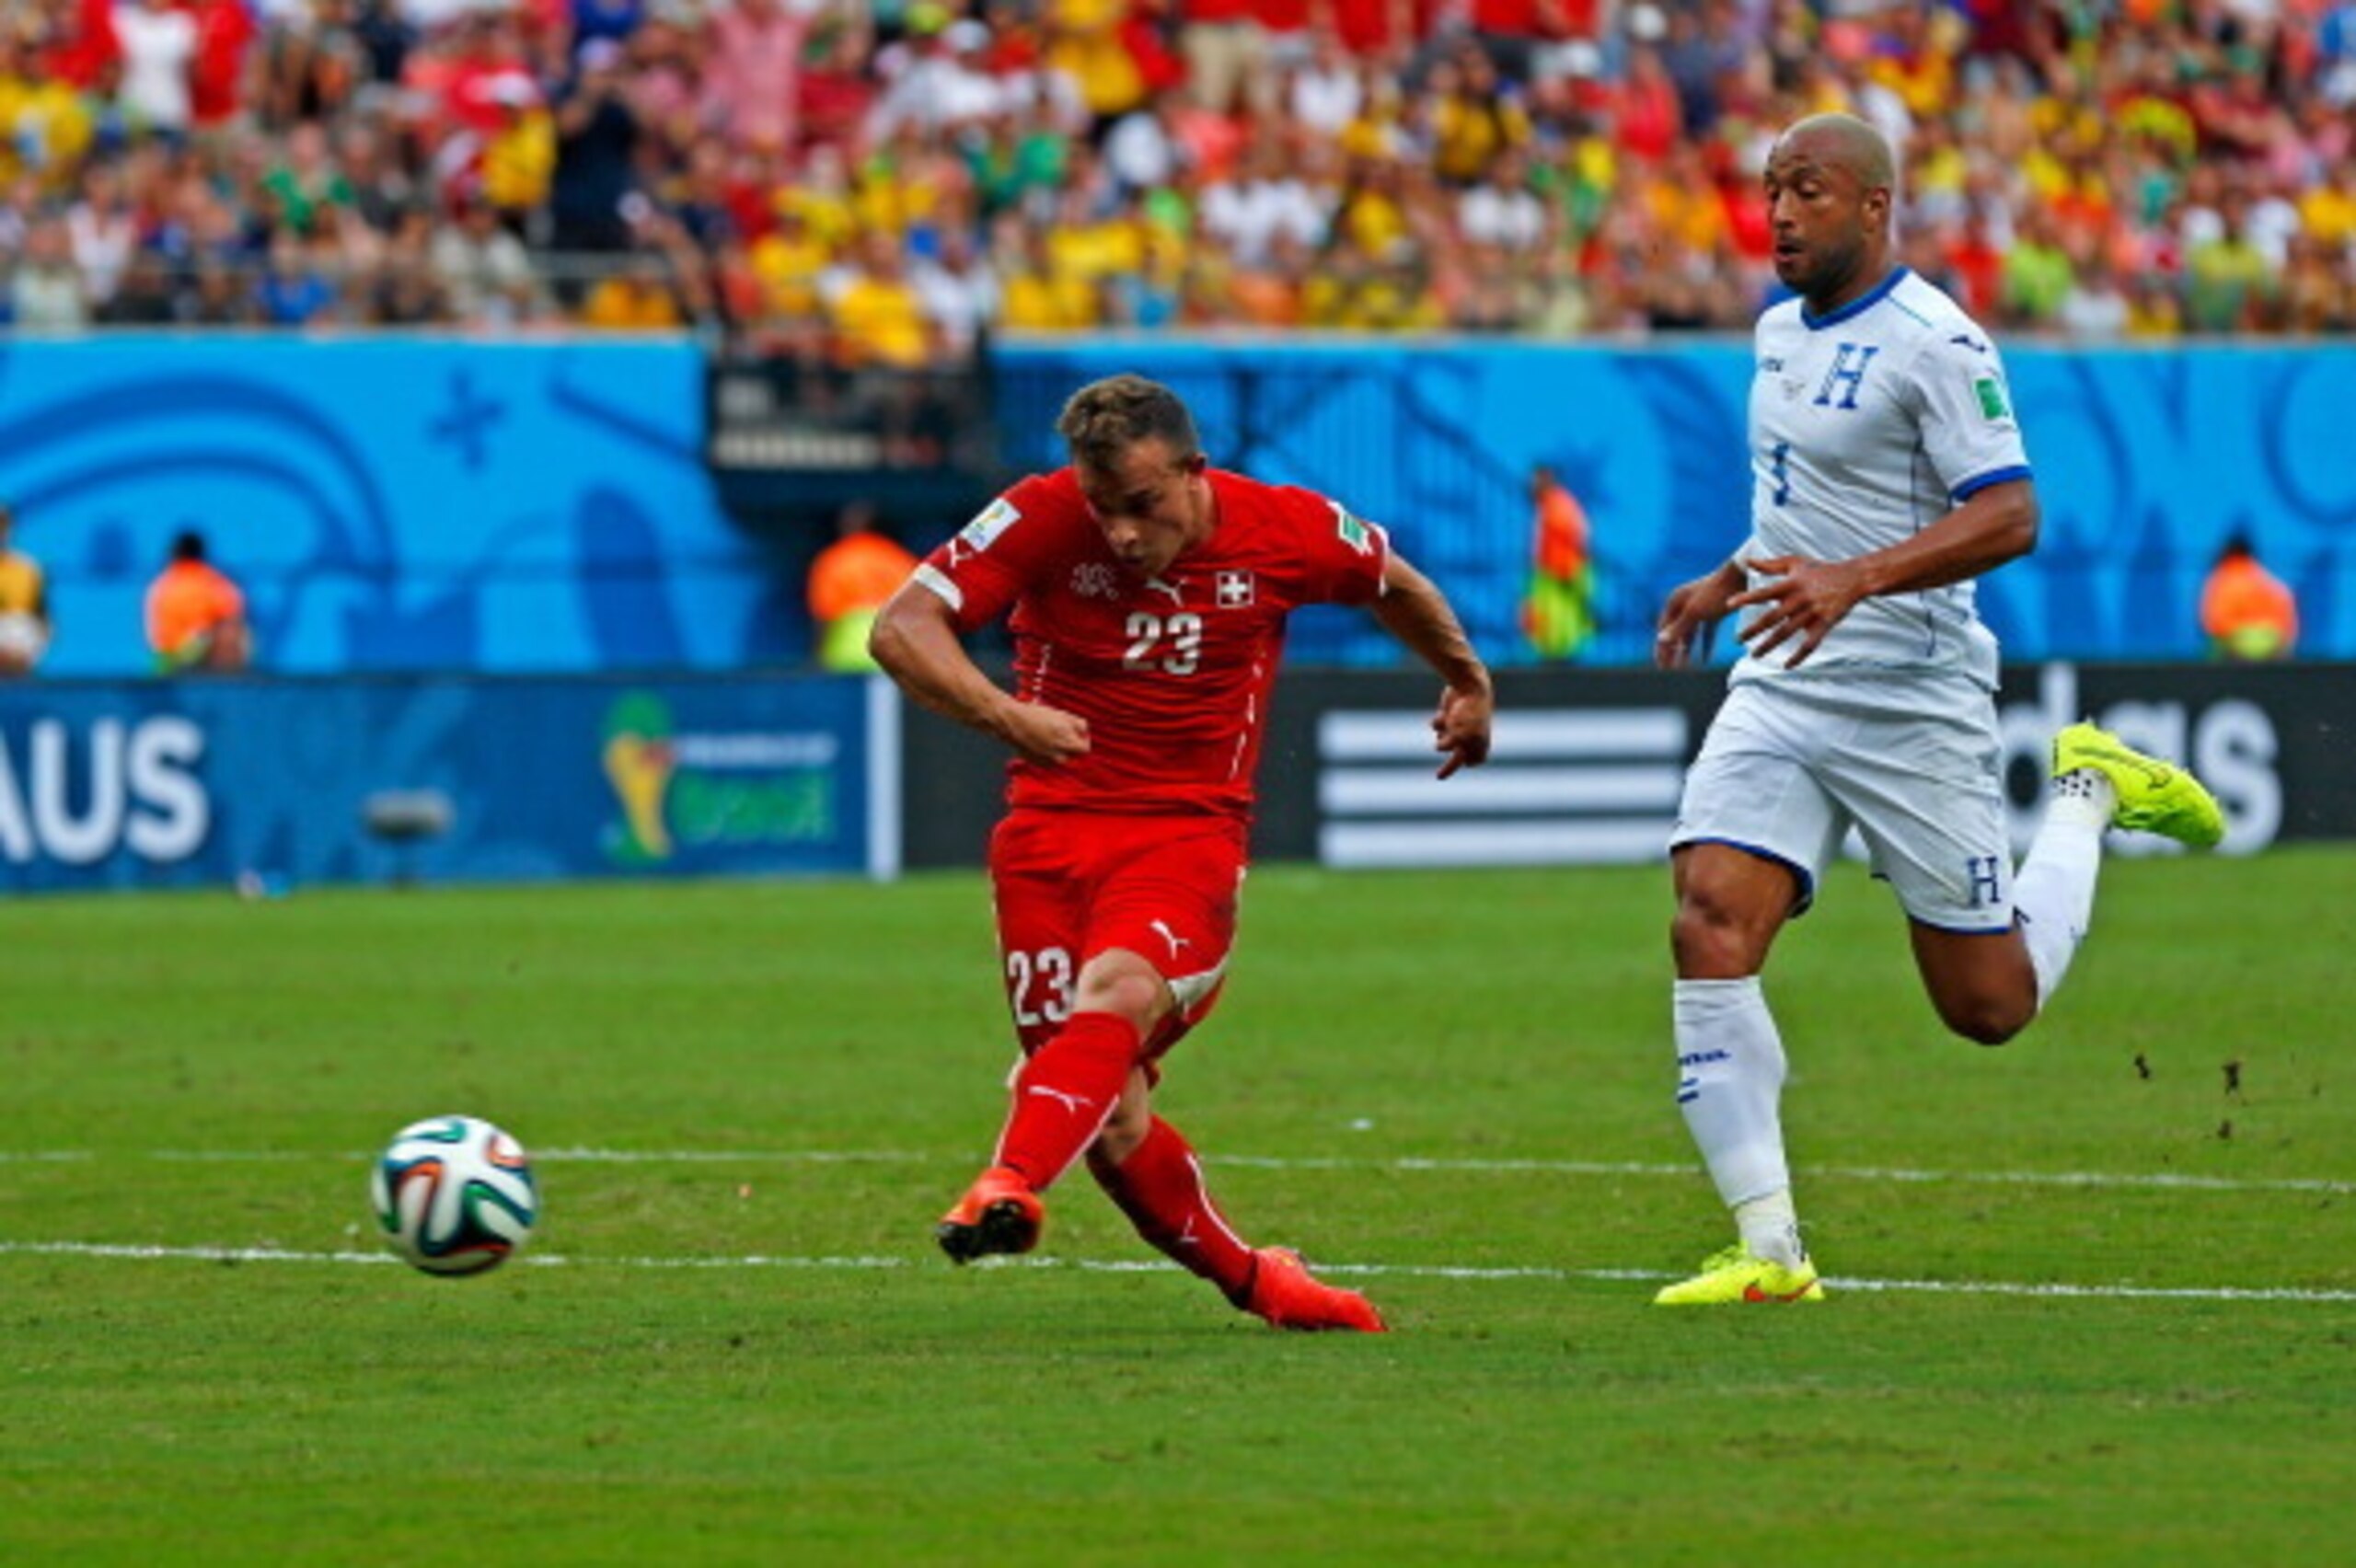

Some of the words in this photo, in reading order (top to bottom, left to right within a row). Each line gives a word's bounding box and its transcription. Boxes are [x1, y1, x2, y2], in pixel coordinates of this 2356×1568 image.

[1813, 342, 1879, 409] H
[1124, 612, 1202, 675] 23
[1968, 856, 2001, 908] H
[1008, 947, 1073, 1027] 23
